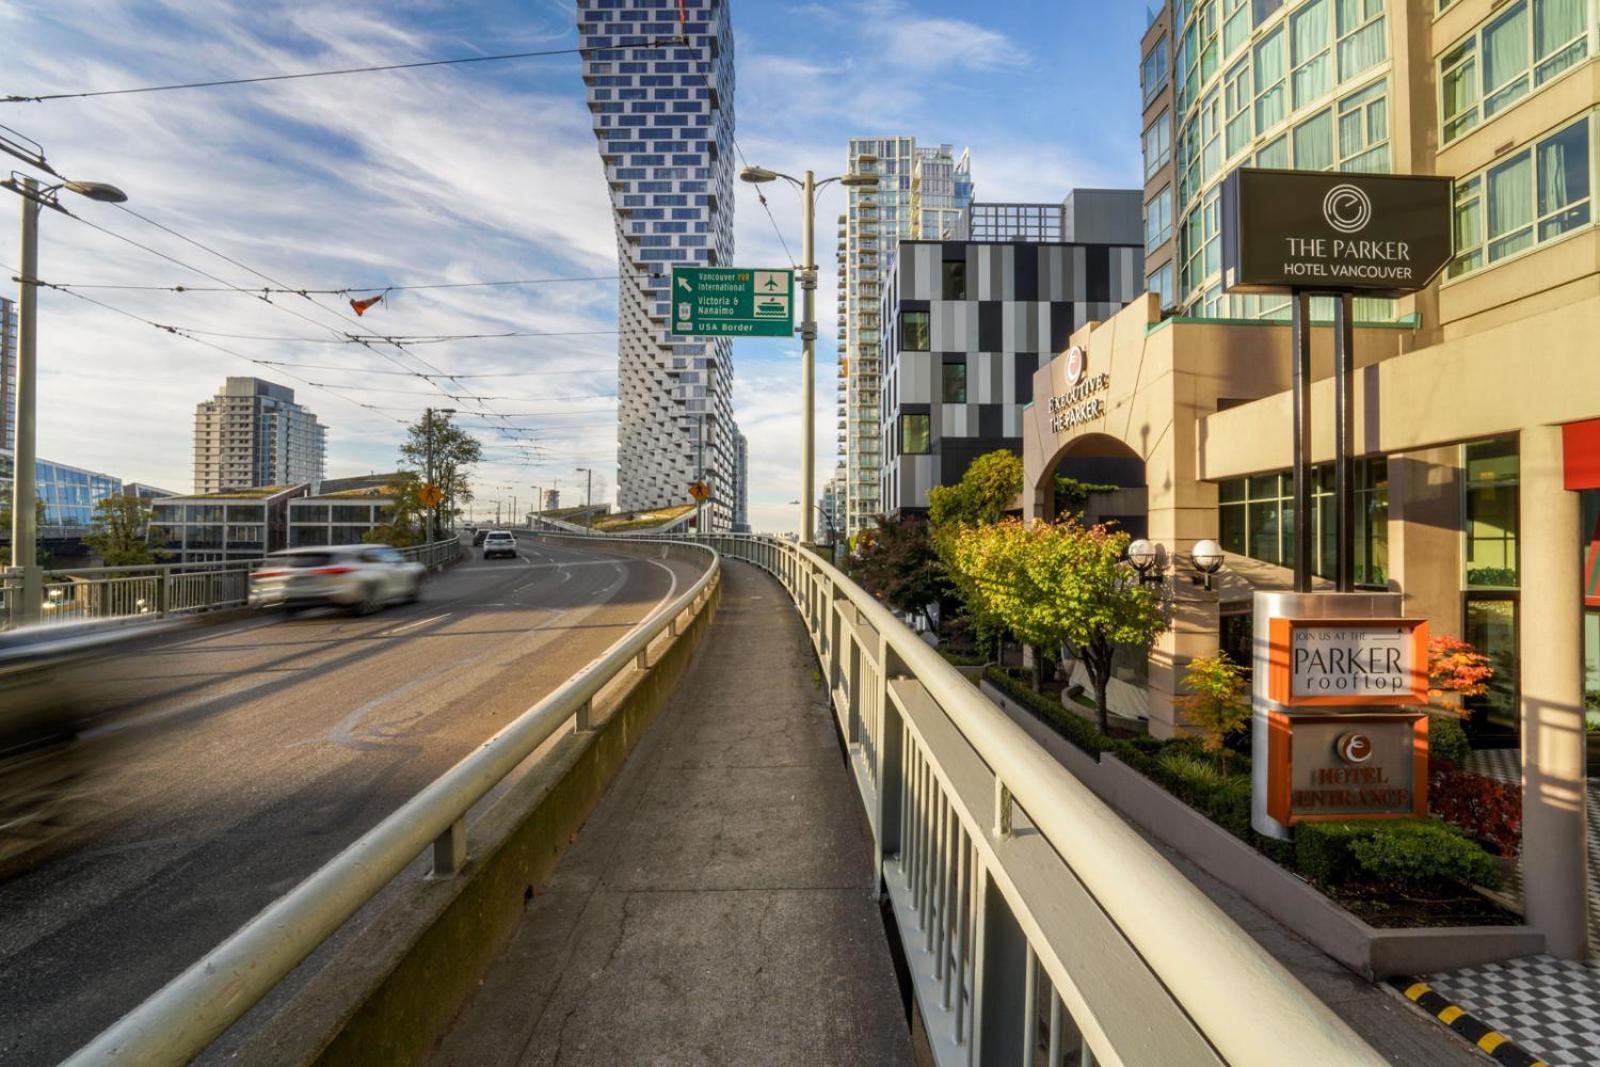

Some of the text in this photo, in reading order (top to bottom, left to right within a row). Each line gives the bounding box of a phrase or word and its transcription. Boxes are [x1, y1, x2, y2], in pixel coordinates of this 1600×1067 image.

[1285, 237, 1410, 261] THE PARKER
[698, 272, 735, 281] Vancouver
[1284, 263, 1412, 279] HOTEL VANCOUVER
[698, 282, 745, 292] International
[698, 295, 730, 305] Victoria
[698, 305, 734, 315] Nanaimo
[699, 323, 718, 331] USA
[721, 323, 753, 332] Border
[1067, 398, 1101, 425] PARKER
[1295, 631, 1315, 641] JOIN
[1319, 631, 1331, 641] US
[1335, 631, 1346, 641] AT
[1295, 647, 1403, 675] PARKER
[1306, 671, 1403, 692] rooftop
[1318, 767, 1389, 785] HOTEL
